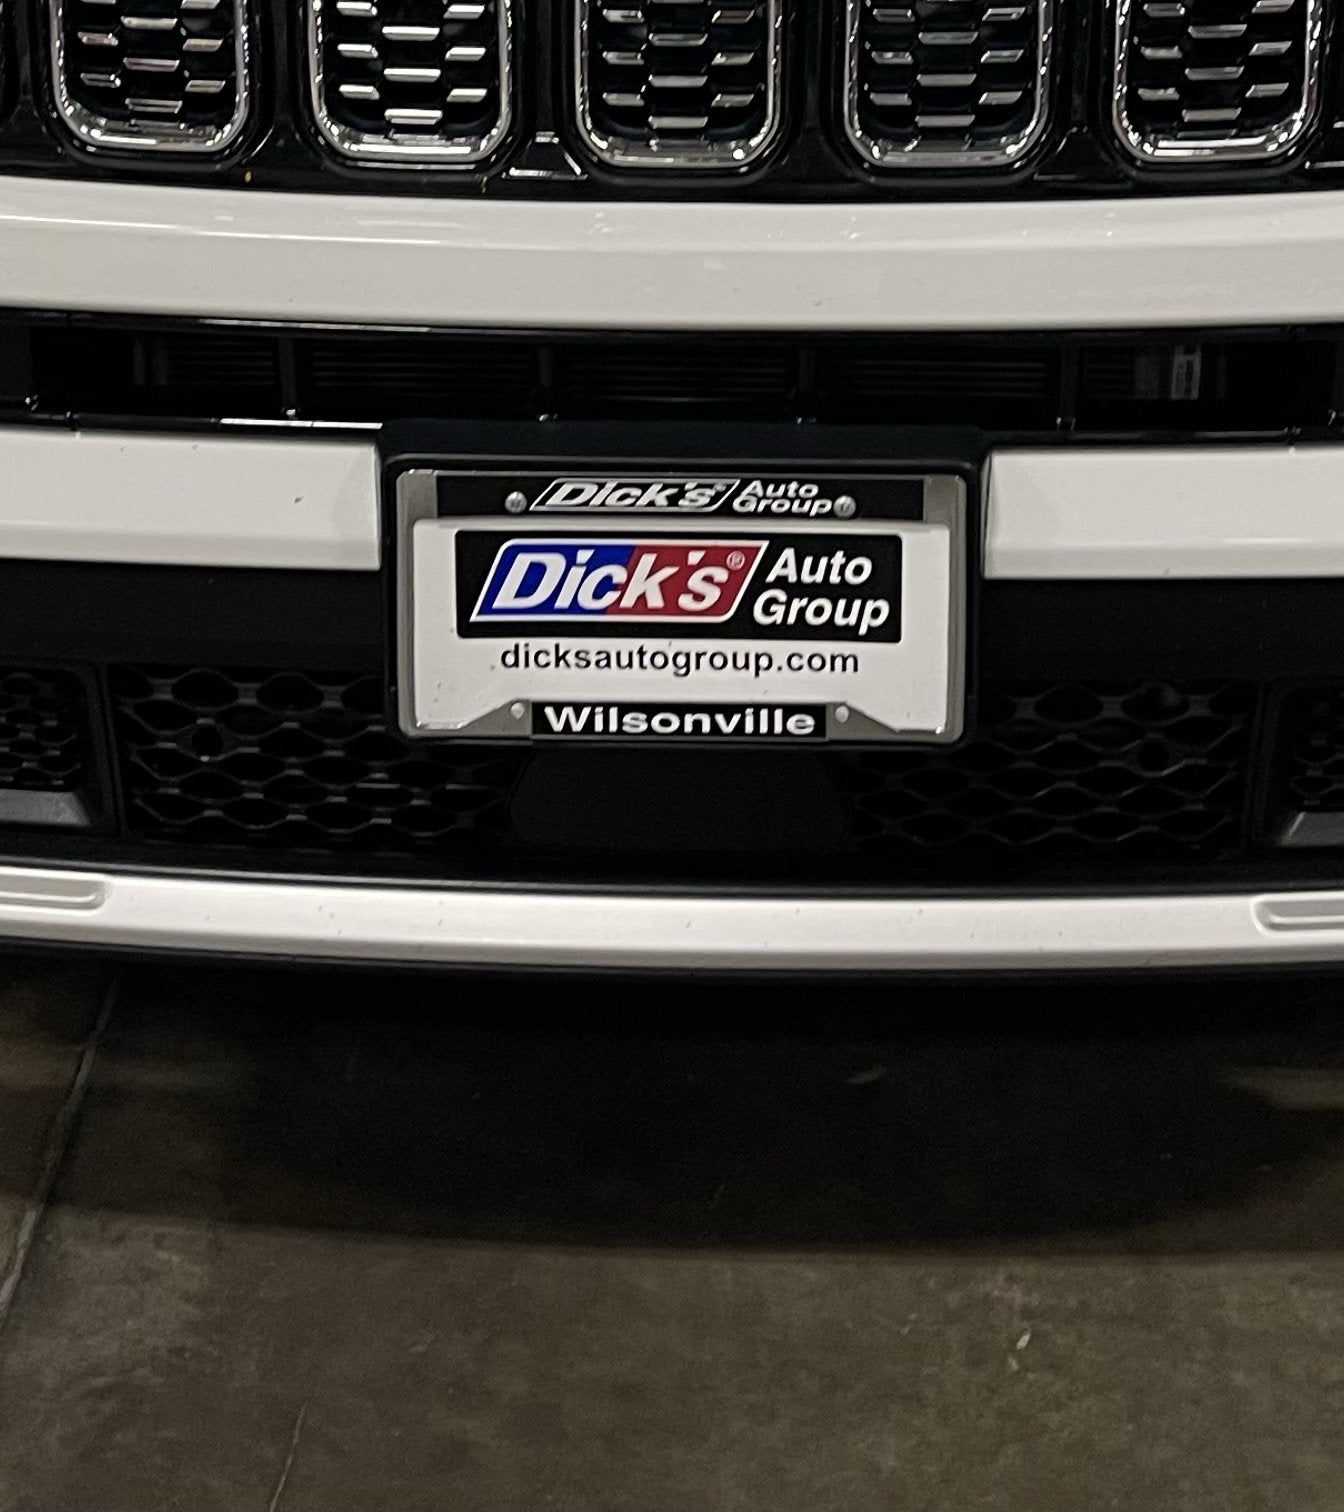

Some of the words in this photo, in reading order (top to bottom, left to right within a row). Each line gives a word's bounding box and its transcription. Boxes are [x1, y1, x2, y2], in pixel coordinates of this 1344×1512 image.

[544, 480, 718, 508] Dick's
[740, 479, 819, 498] Auto
[731, 495, 833, 517] Group
[490, 549, 730, 612] Dick's
[766, 548, 873, 586] Auto
[752, 588, 891, 635] Group
[500, 643, 860, 678] dicksautogroup.com
[543, 705, 817, 736] Wilsonville
